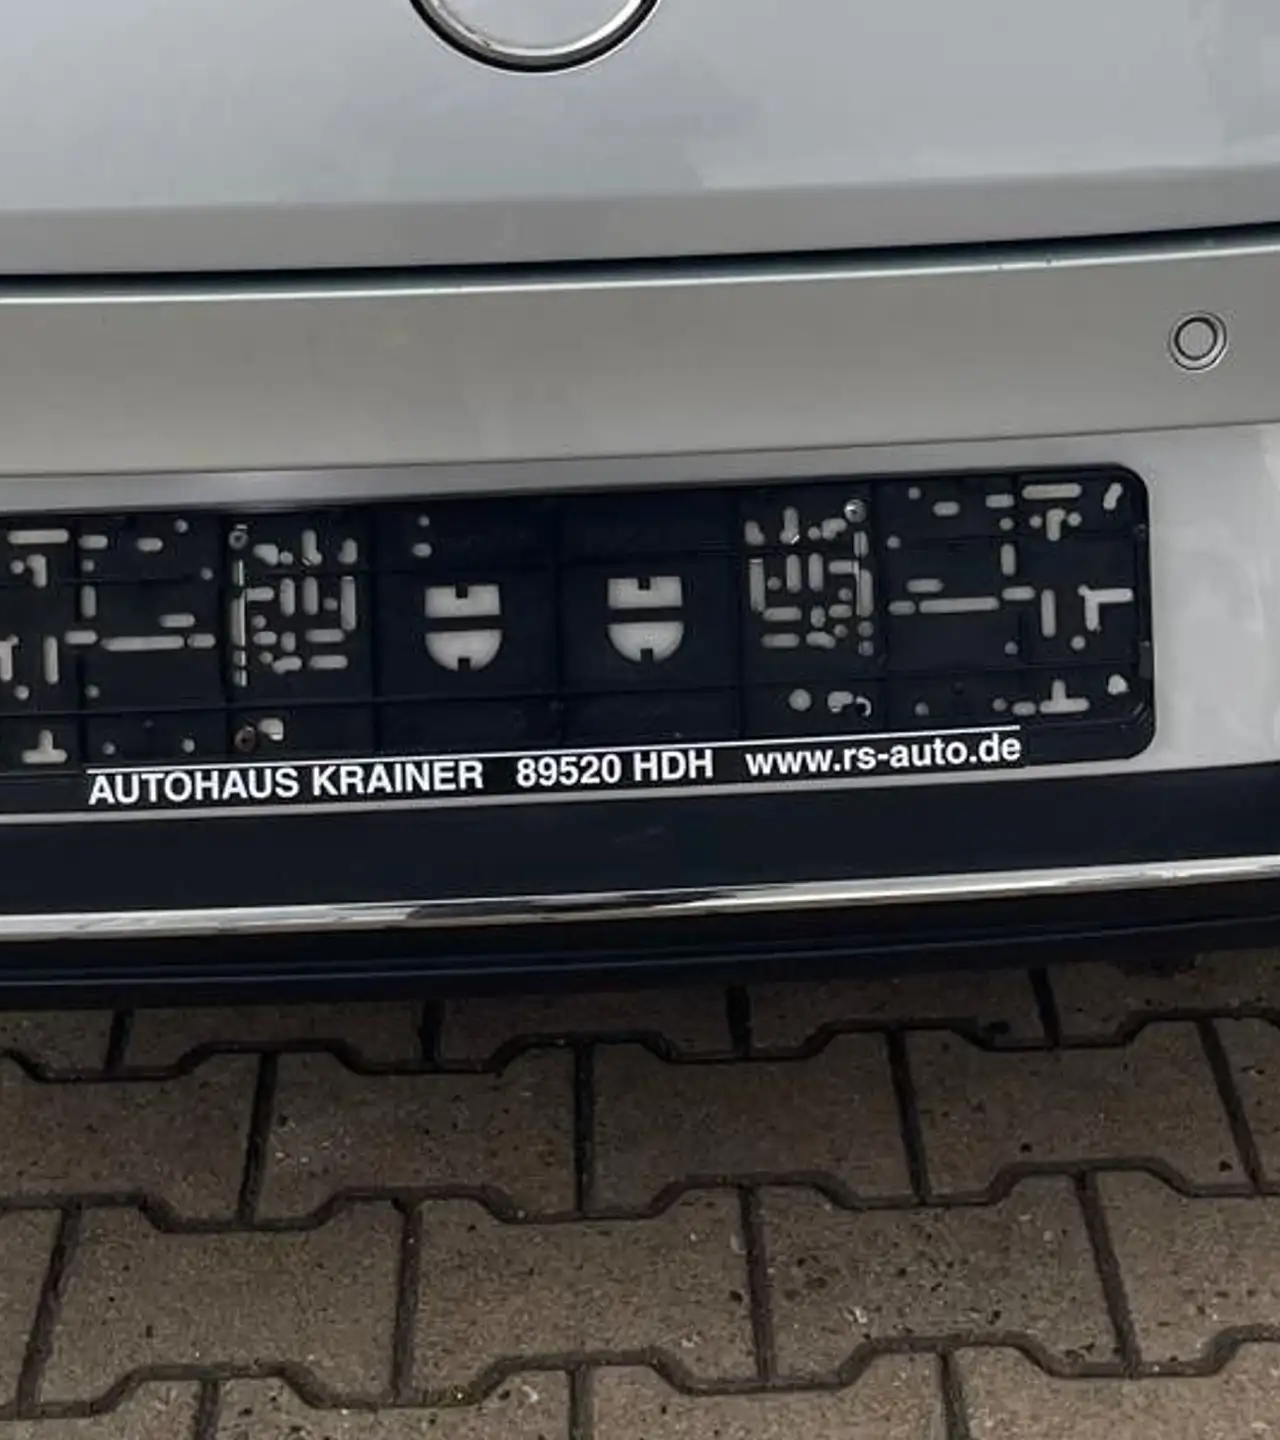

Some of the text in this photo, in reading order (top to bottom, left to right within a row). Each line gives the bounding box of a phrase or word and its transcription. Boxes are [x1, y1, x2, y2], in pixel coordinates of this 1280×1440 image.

[88, 731, 1022, 806] AUTOHAUS KRAINER 89520 HDH www.rs-auto.de
